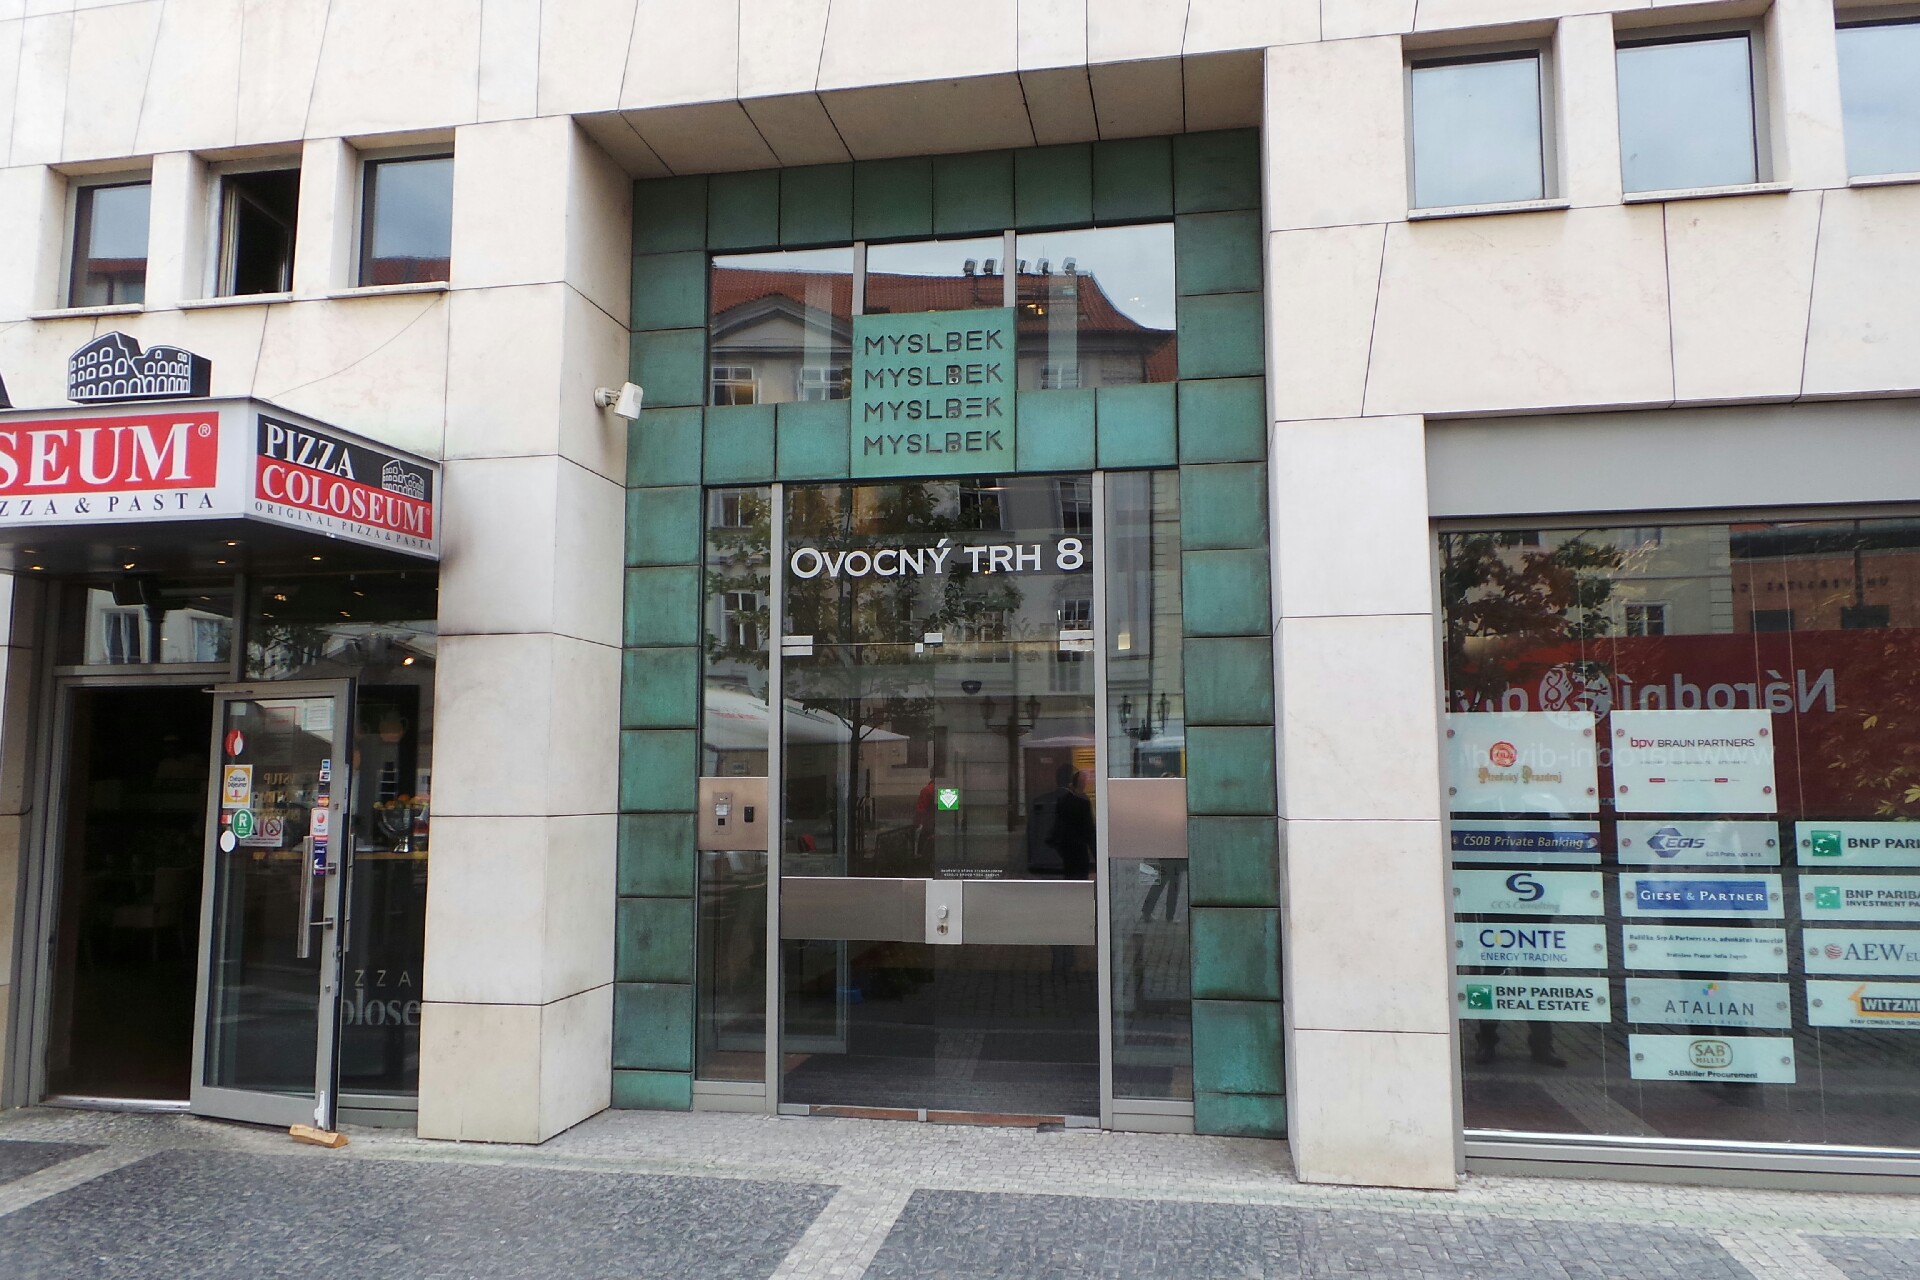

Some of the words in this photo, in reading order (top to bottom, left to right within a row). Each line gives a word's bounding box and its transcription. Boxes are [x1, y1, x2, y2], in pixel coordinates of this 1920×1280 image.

[865, 329, 1003, 355] MYSLBEK
[864, 363, 1003, 389] MYSLBEK
[864, 397, 1003, 422] MYSLBEK
[264, 422, 355, 480] PIZZA
[864, 430, 1003, 456] MYSLBEK
[75, 497, 90, 514] &
[108, 492, 213, 513] PASTA
[262, 464, 425, 534] COLOSEUM
[255, 501, 332, 527] ORIGINAL
[342, 521, 380, 539] PIZZA
[385, 533, 391, 541] &
[396, 534, 432, 550] PASTA
[963, 544, 1042, 573] TRH
[1056, 537, 1084, 570] 8
[1630, 737, 1654, 749] bpv
[1658, 739, 1695, 747] BRAUN
[1698, 738, 1755, 747] PARTNERS
[1463, 834, 1490, 846] ČSOB
[1494, 836, 1533, 846] Private
[1538, 837, 1584, 849] Banking
[1666, 838, 1706, 848] EGIS
[1847, 838, 1880, 848] BNP
[1686, 892, 1695, 901] &
[1845, 889, 1873, 898] BNP
[1479, 929, 1566, 949] CONTE
[1480, 952, 1520, 961] ENERGY
[1523, 952, 1568, 962] TRADING
[1843, 942, 1905, 961] AEW
[1496, 986, 1526, 996] BNP
[1531, 987, 1594, 998] PARIBAS
[1497, 999, 1534, 1010] REAL
[1538, 1000, 1590, 1011] ESTATE
[1664, 999, 1754, 1016] ATALIAN
[1695, 1044, 1726, 1057] SAB
[1707, 1070, 1758, 1079] Procurement
